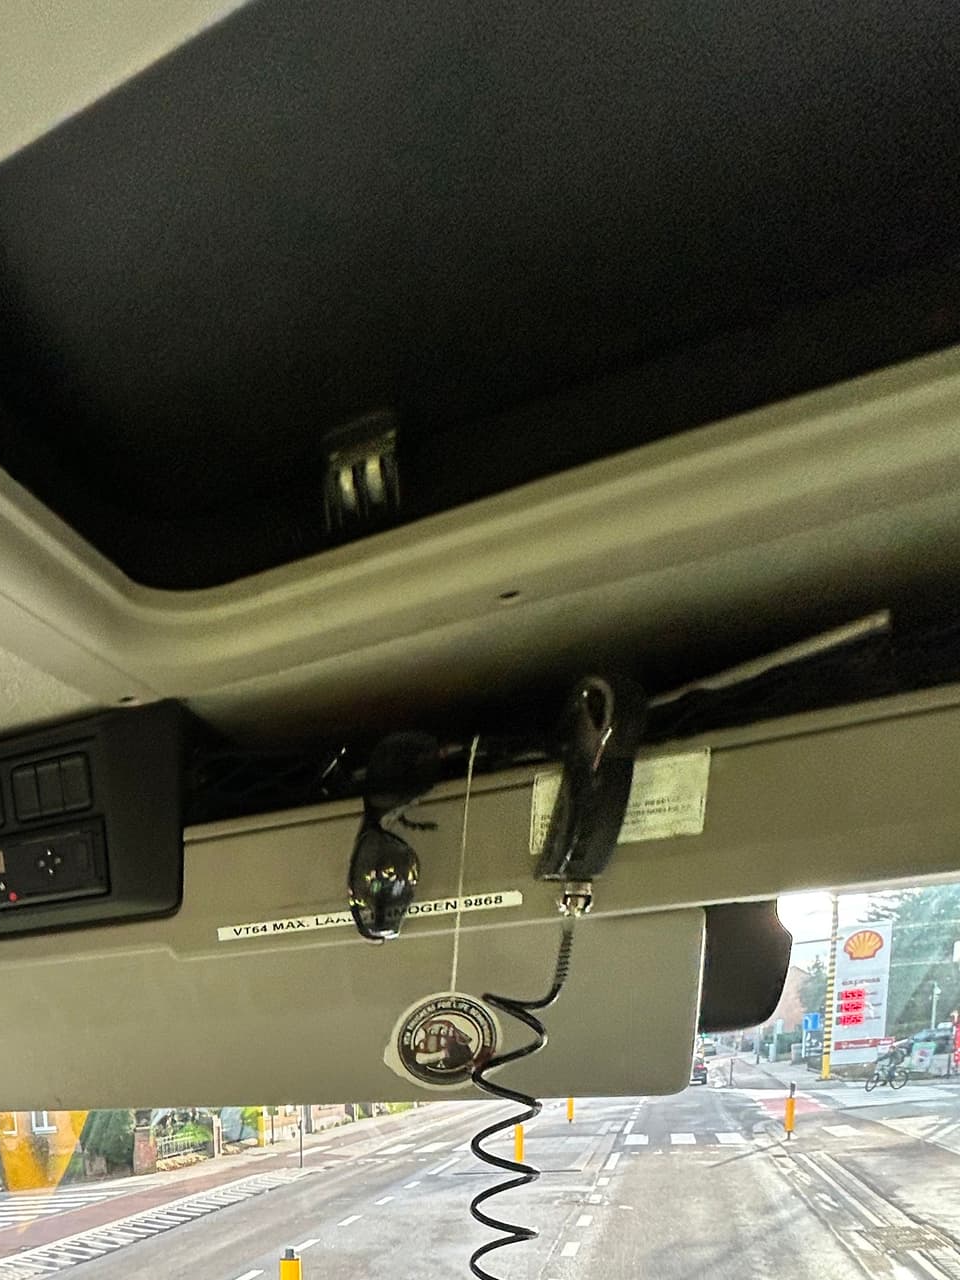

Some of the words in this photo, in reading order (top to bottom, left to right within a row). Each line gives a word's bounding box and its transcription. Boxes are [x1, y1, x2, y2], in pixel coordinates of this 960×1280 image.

[233, 925, 267, 936] VT64
[272, 920, 309, 932] MAX.
[463, 895, 504, 908] 9868
